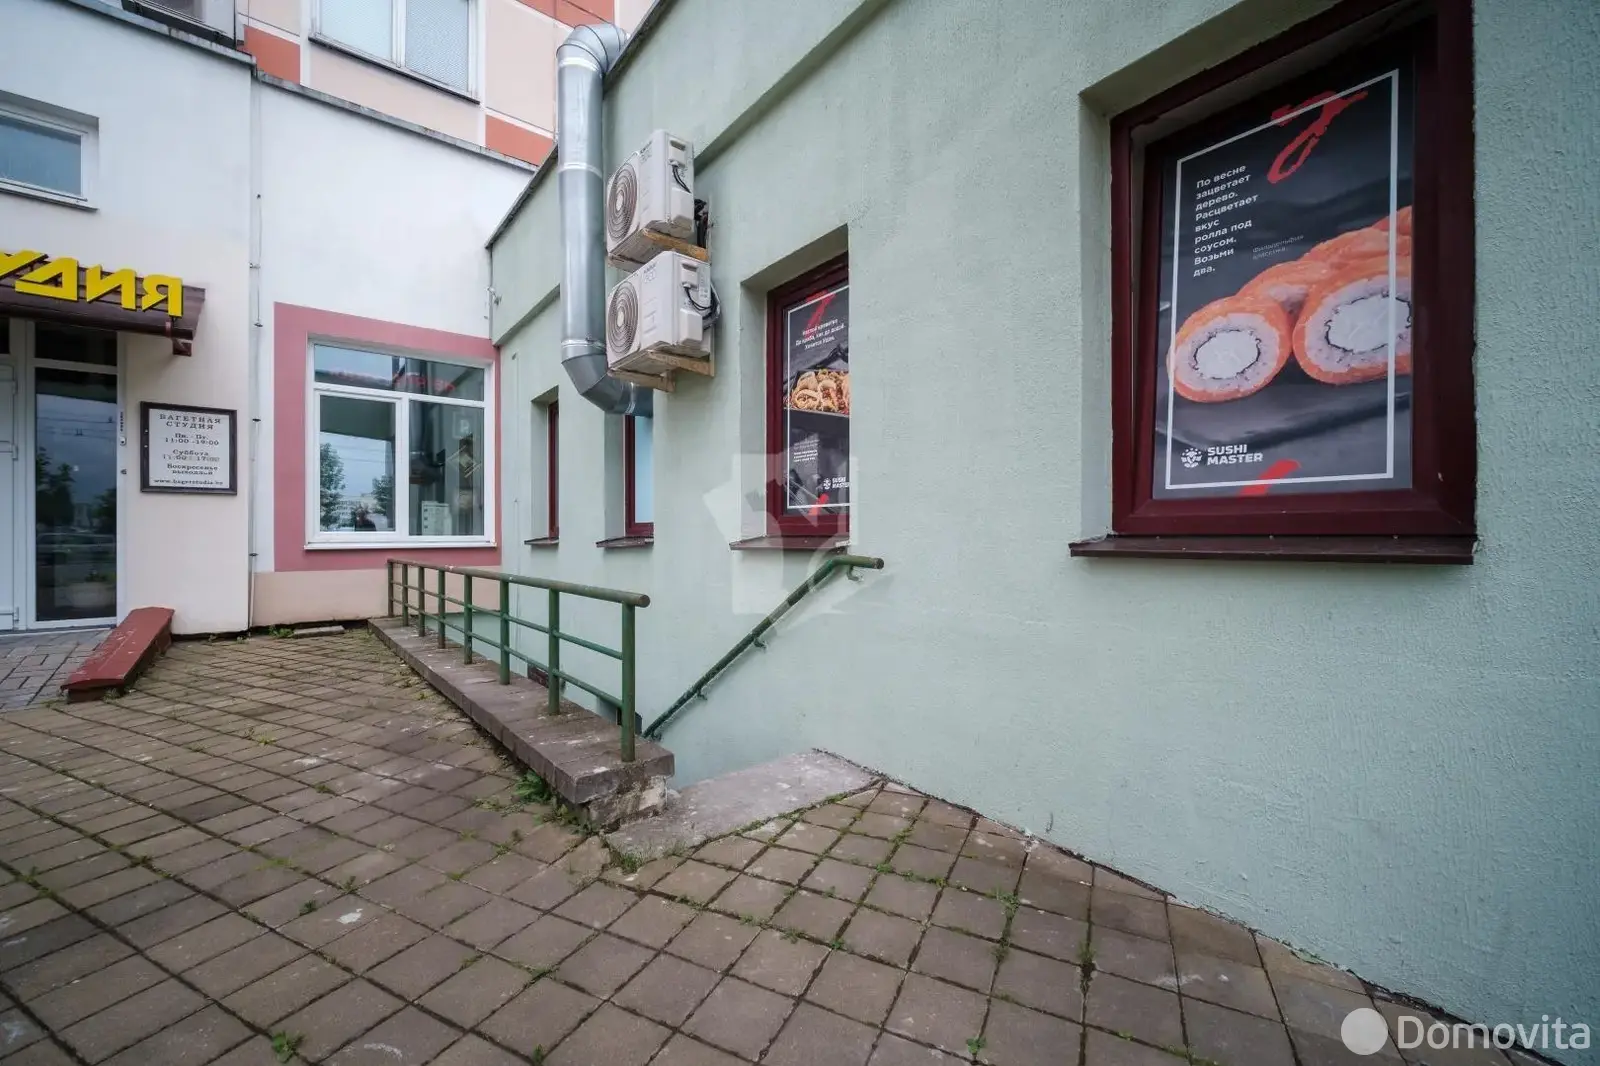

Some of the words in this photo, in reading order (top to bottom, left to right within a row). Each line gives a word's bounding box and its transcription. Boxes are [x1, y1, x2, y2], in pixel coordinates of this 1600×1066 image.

[1196, 179, 1211, 189] По
[1213, 165, 1247, 182] весне
[1195, 174, 1252, 200] зацветает
[1195, 192, 1239, 211] дерево.
[1195, 194, 1260, 221] Расцветает
[1194, 227, 1228, 244] ролла
[1230, 219, 1253, 231] под
[1195, 219, 1220, 232] вкус
[1194, 236, 1237, 254] соусом.
[1194, 248, 1235, 265] Возьми
[1193, 266, 1216, 278] два.
[166, 421, 214, 430] СТУДИЯ
[1207, 444, 1248, 456] SUSHI
[1206, 452, 1264, 466] MASTER
